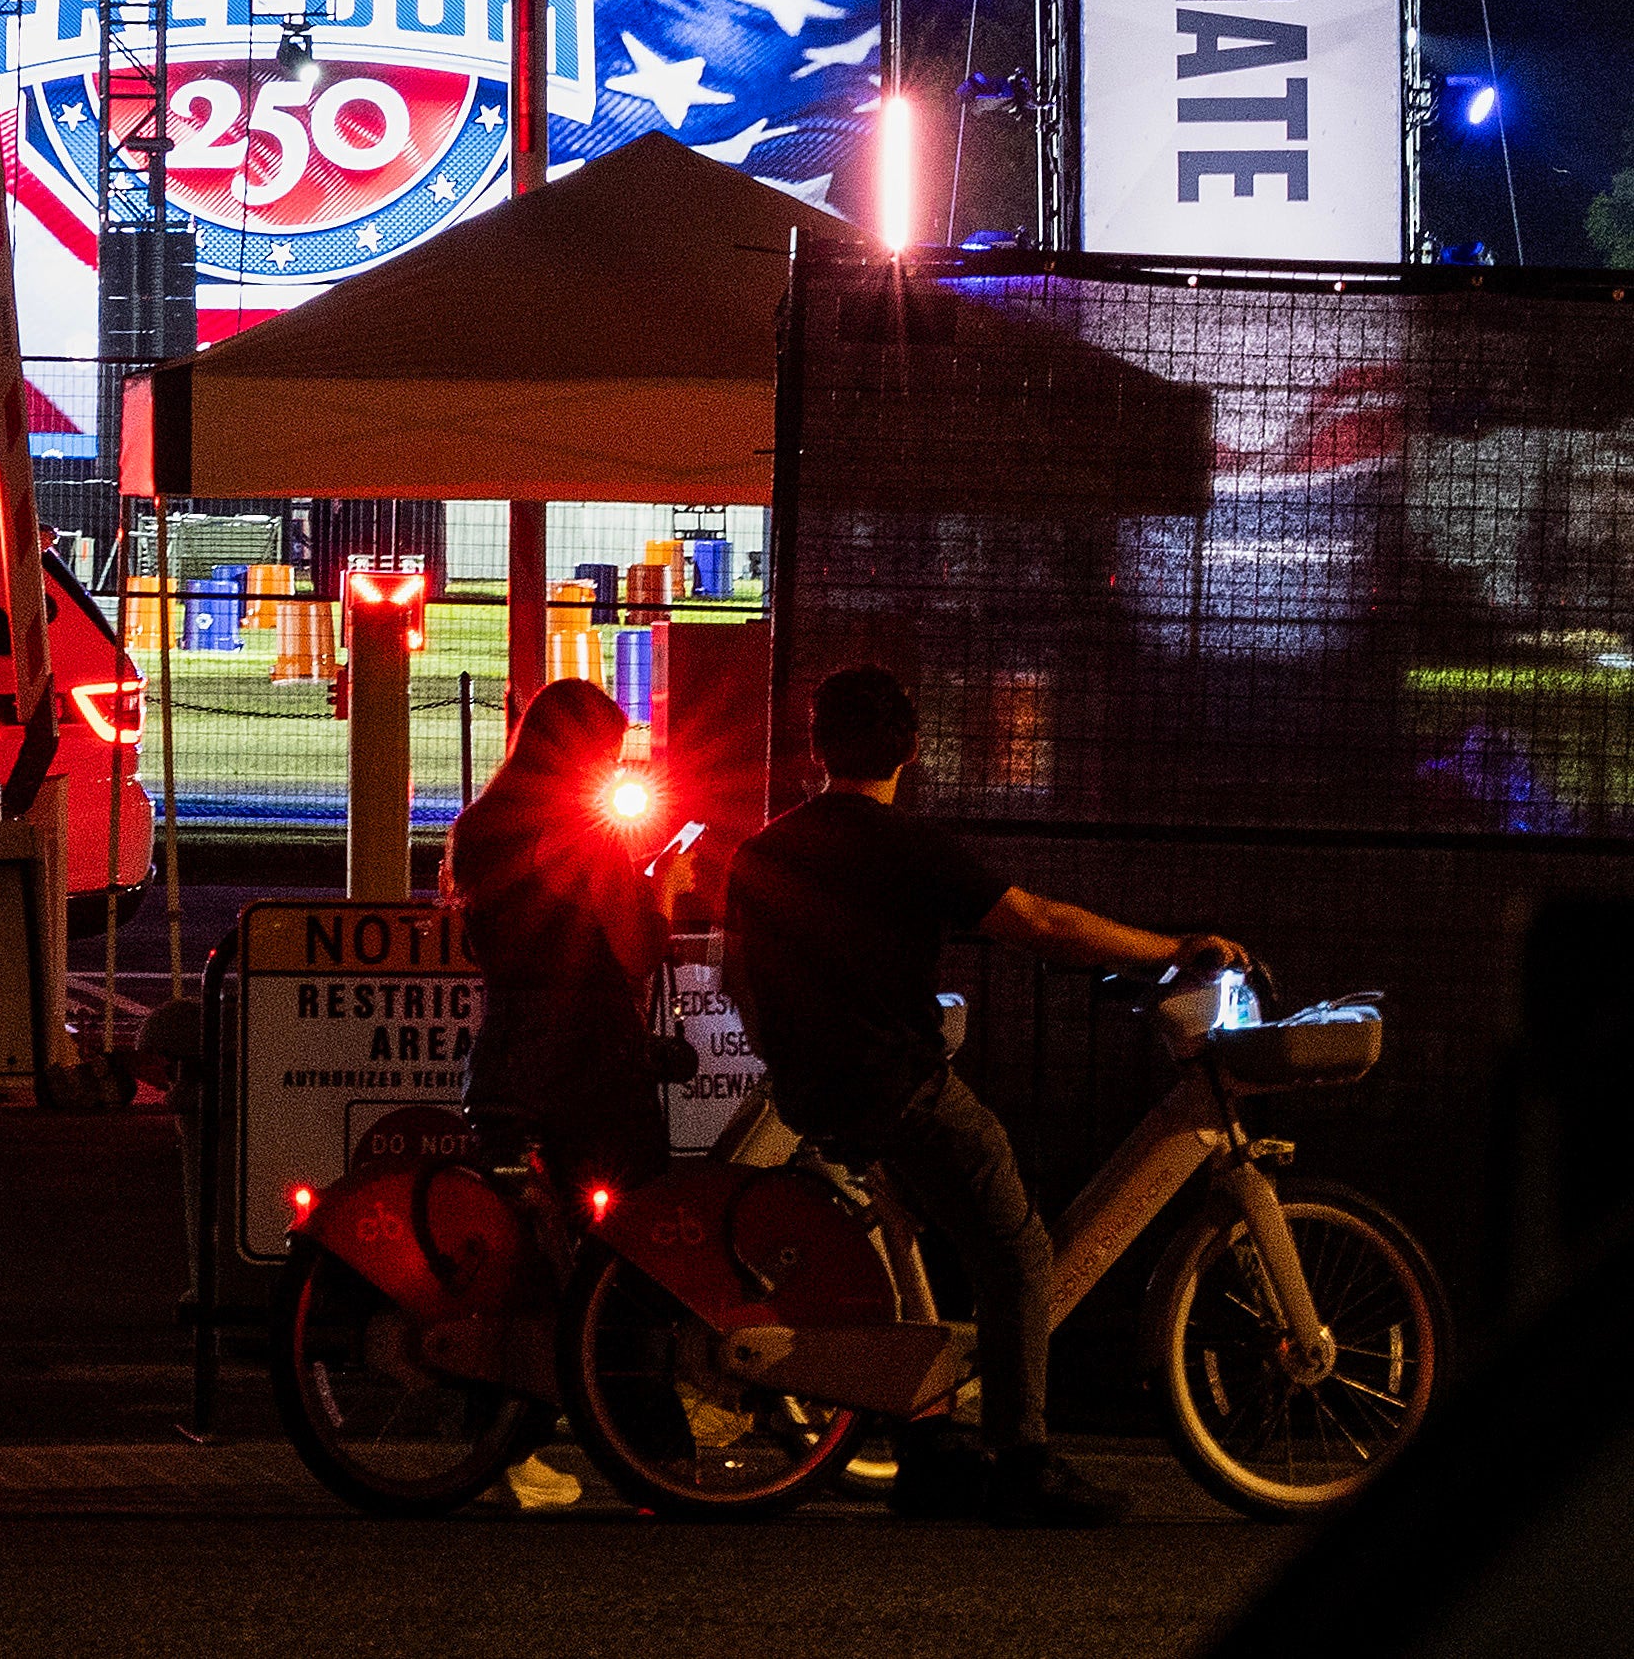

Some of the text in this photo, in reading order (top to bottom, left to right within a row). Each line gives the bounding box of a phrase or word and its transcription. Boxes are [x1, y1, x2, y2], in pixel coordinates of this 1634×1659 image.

[164, 77, 411, 207] 250
[284, 1071, 402, 1087] AUTHORIZED
[371, 1134, 406, 1156] DO
